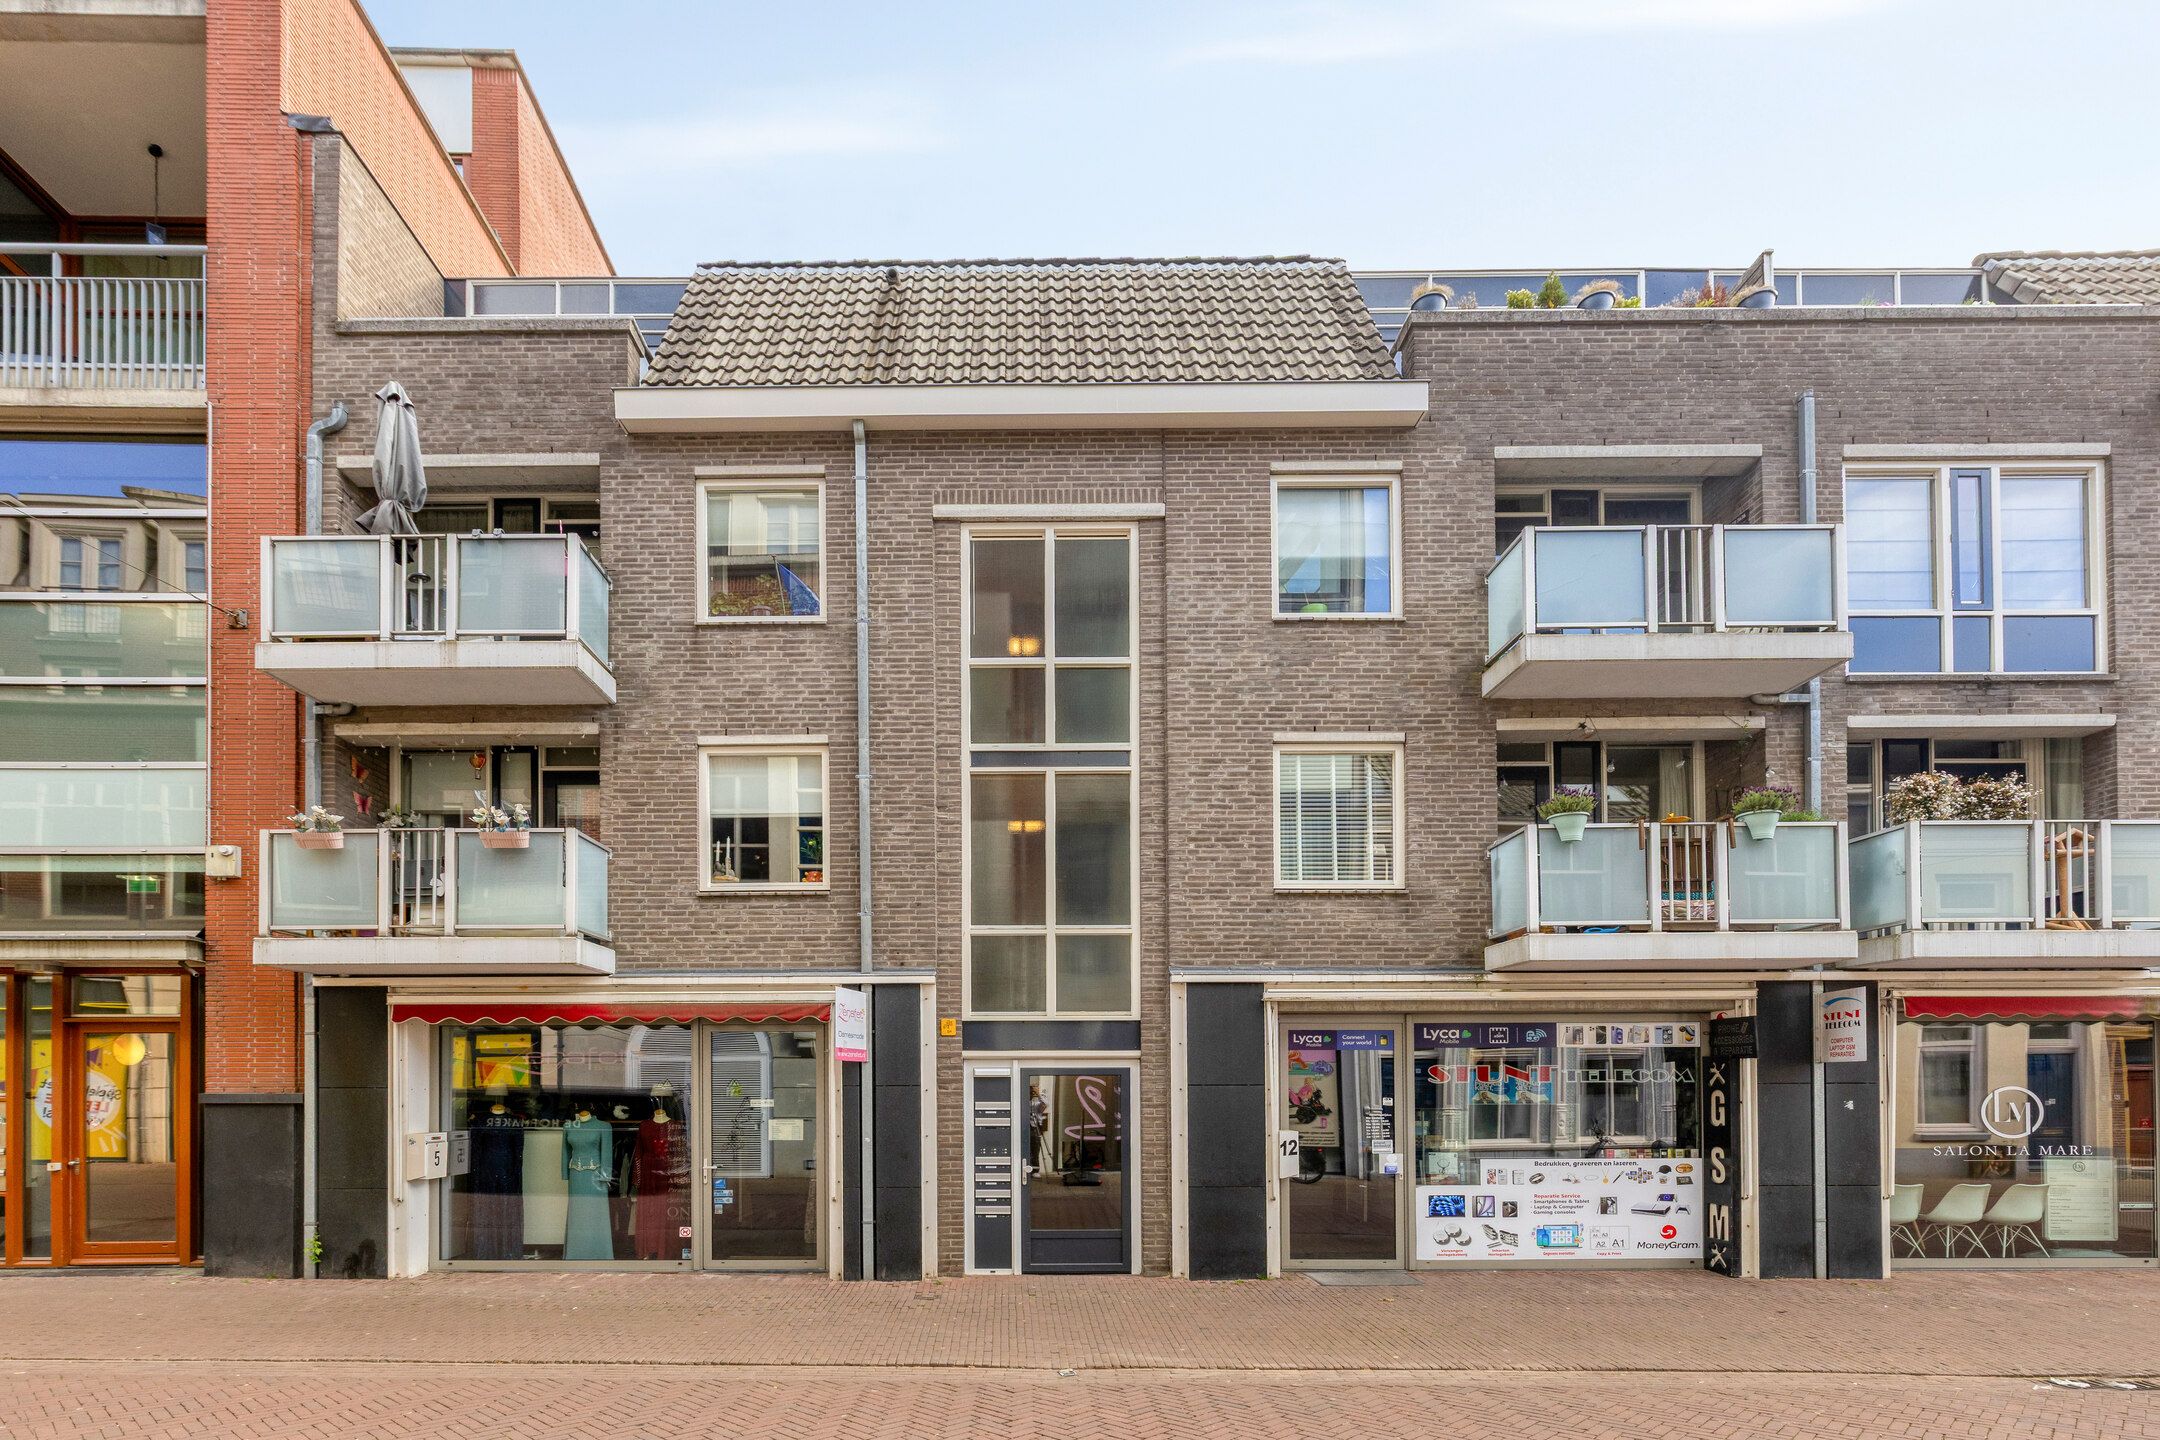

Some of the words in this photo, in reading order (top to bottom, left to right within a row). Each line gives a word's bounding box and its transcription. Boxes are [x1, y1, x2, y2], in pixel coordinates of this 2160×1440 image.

[1823, 1009, 1861, 1021] STUNT
[1825, 1020, 1861, 1030] TELECOM
[1293, 1034, 1322, 1045] Lyca
[1423, 1027, 1460, 1040] Lyca
[1427, 1064, 1560, 1084] STUNT
[1562, 1067, 1696, 1083] TELECOM
[1280, 1140, 1299, 1156] 12
[1933, 1145, 1997, 1157] SALON
[2006, 1145, 2031, 1156] LA
[2039, 1145, 2094, 1156] MARE
[434, 1150, 440, 1167] 5
[1534, 1160, 1572, 1168] Bedrukken,
[1612, 1238, 1625, 1247] A1
